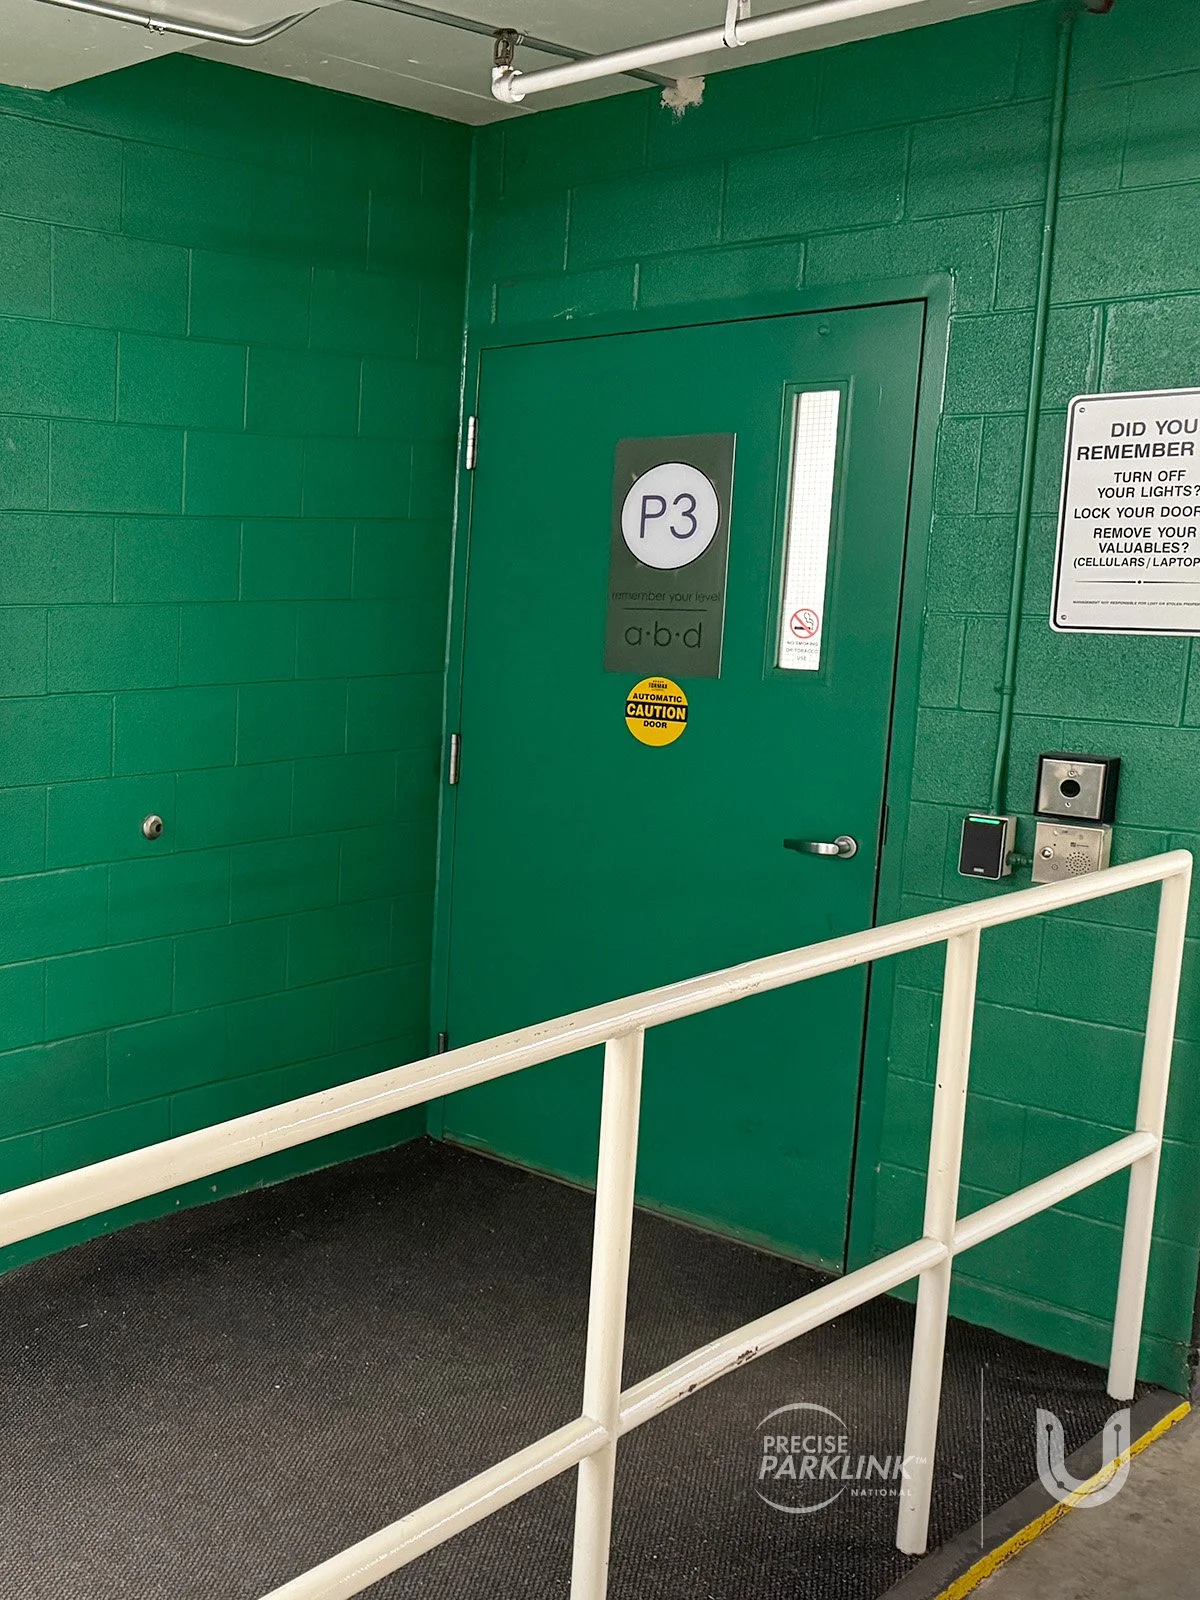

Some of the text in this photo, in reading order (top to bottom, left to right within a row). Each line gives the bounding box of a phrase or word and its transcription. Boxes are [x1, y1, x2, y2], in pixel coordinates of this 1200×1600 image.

[1111, 418, 1198, 437] DID YOU
[1077, 441, 1194, 461] REMEMBER
[1114, 470, 1186, 483] TURN OFF
[1098, 485, 1200, 499] YOUR LIGHTS?
[640, 492, 698, 539] P3
[1074, 507, 1111, 519] LOCK
[1116, 507, 1155, 518] YOUR
[1093, 526, 1197, 539] REMOVE YOUR
[1099, 542, 1189, 554] VALUABLES?
[612, 591, 720, 604] remember your level
[632, 693, 682, 702] AUTOMATIC
[626, 703, 686, 720] CAUTION
[644, 720, 668, 728] DOOR
